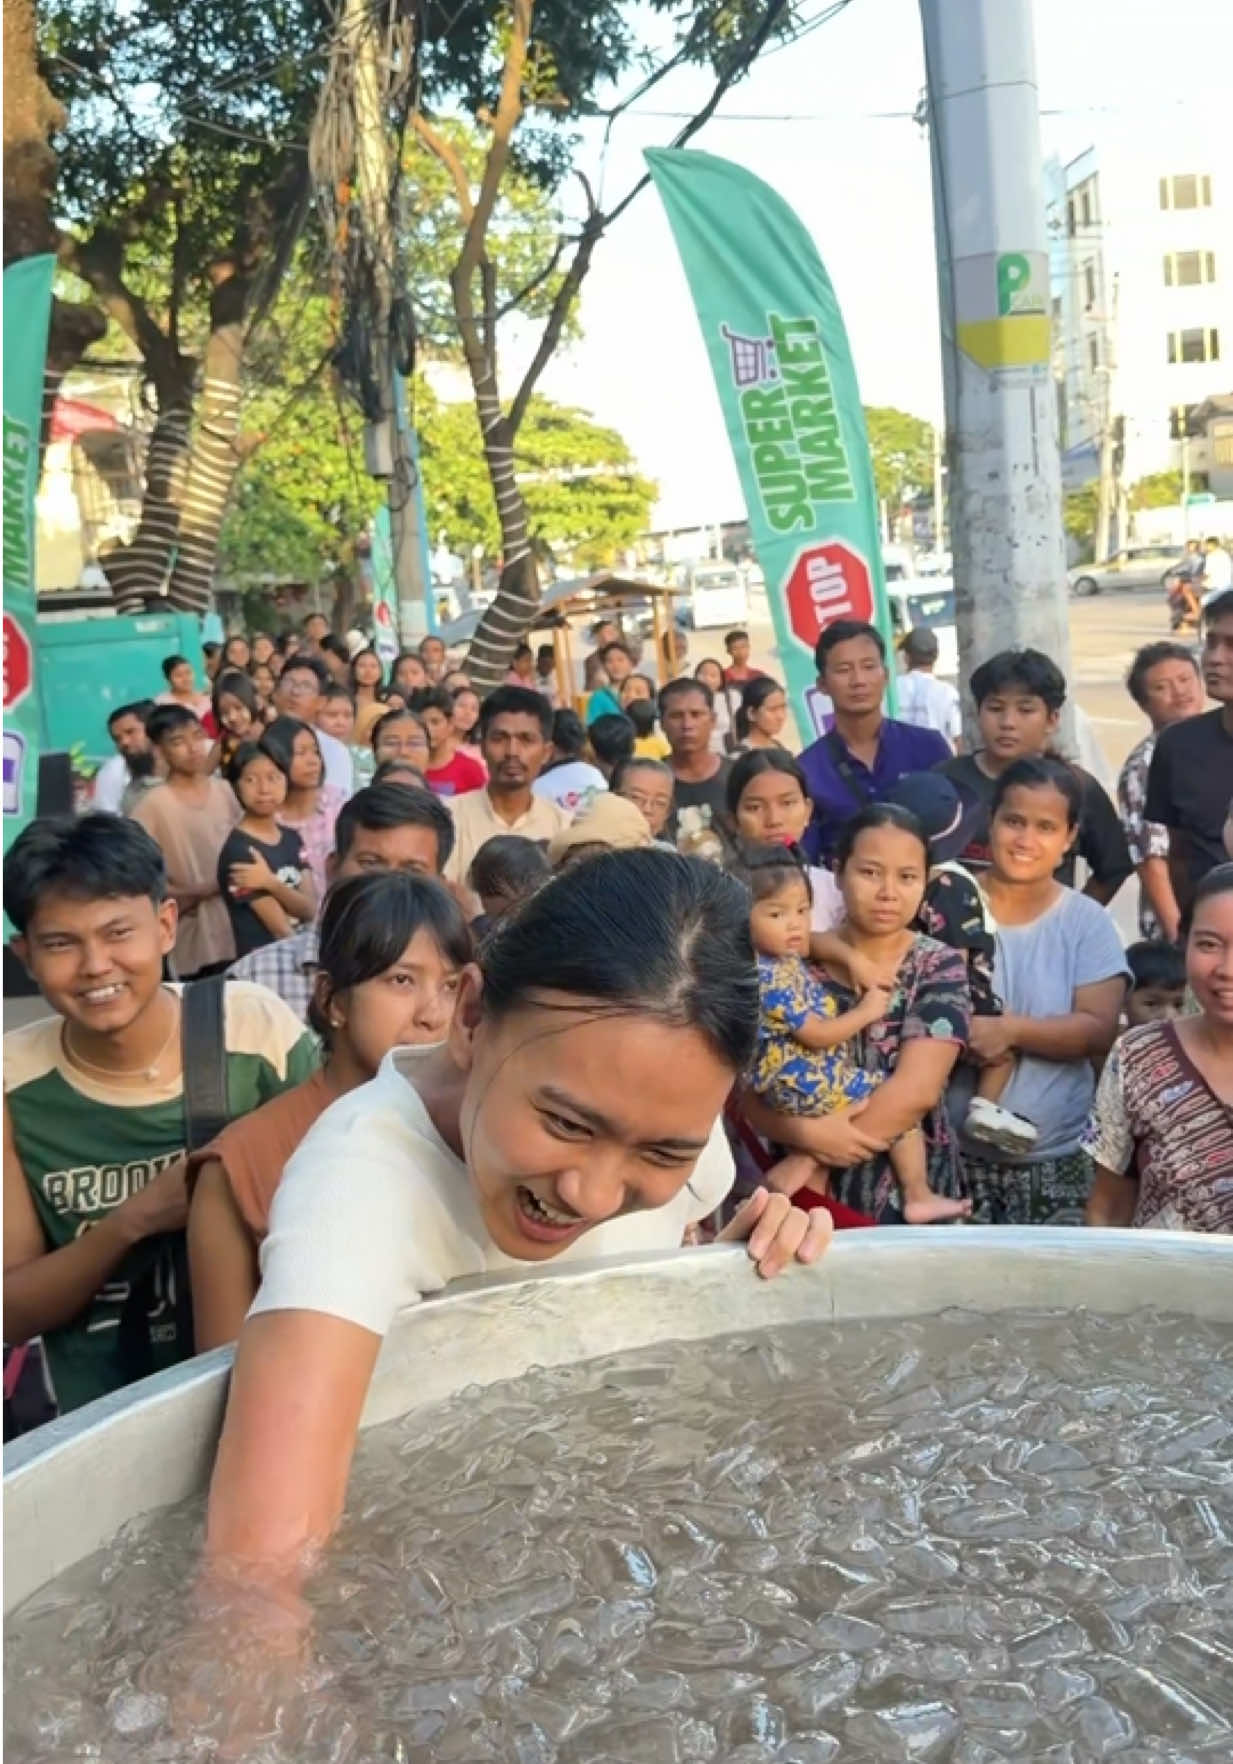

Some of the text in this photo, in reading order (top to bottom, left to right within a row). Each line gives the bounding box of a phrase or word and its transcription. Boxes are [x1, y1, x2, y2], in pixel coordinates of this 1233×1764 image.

[997, 252, 1030, 315] P
[768, 312, 855, 502] MARKET
[741, 385, 816, 532] SUPER
[806, 556, 853, 632] TOP
[43, 1148, 187, 1214] BROO
